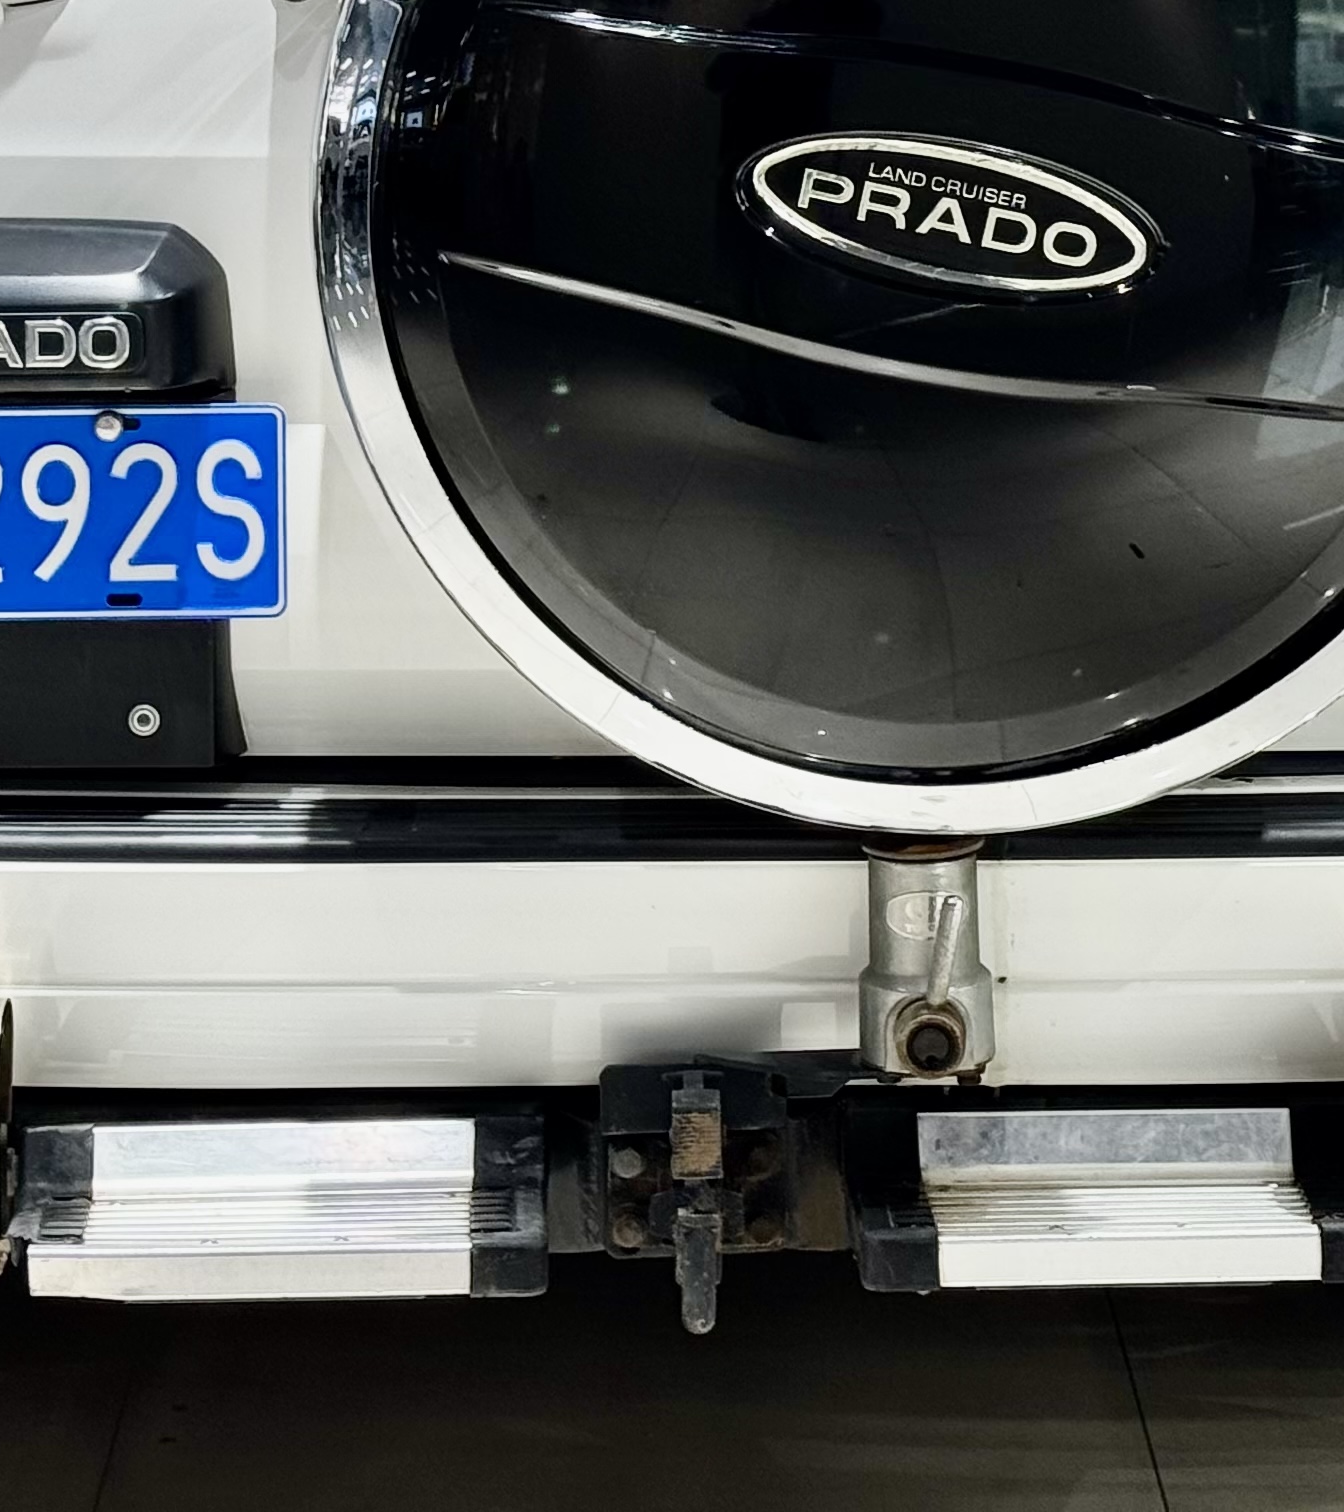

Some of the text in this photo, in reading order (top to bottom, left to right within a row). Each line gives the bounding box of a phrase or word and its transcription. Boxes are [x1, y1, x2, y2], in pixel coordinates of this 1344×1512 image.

[797, 167, 1098, 268] PRADO
[868, 162, 1026, 210] LAND CRUISER
